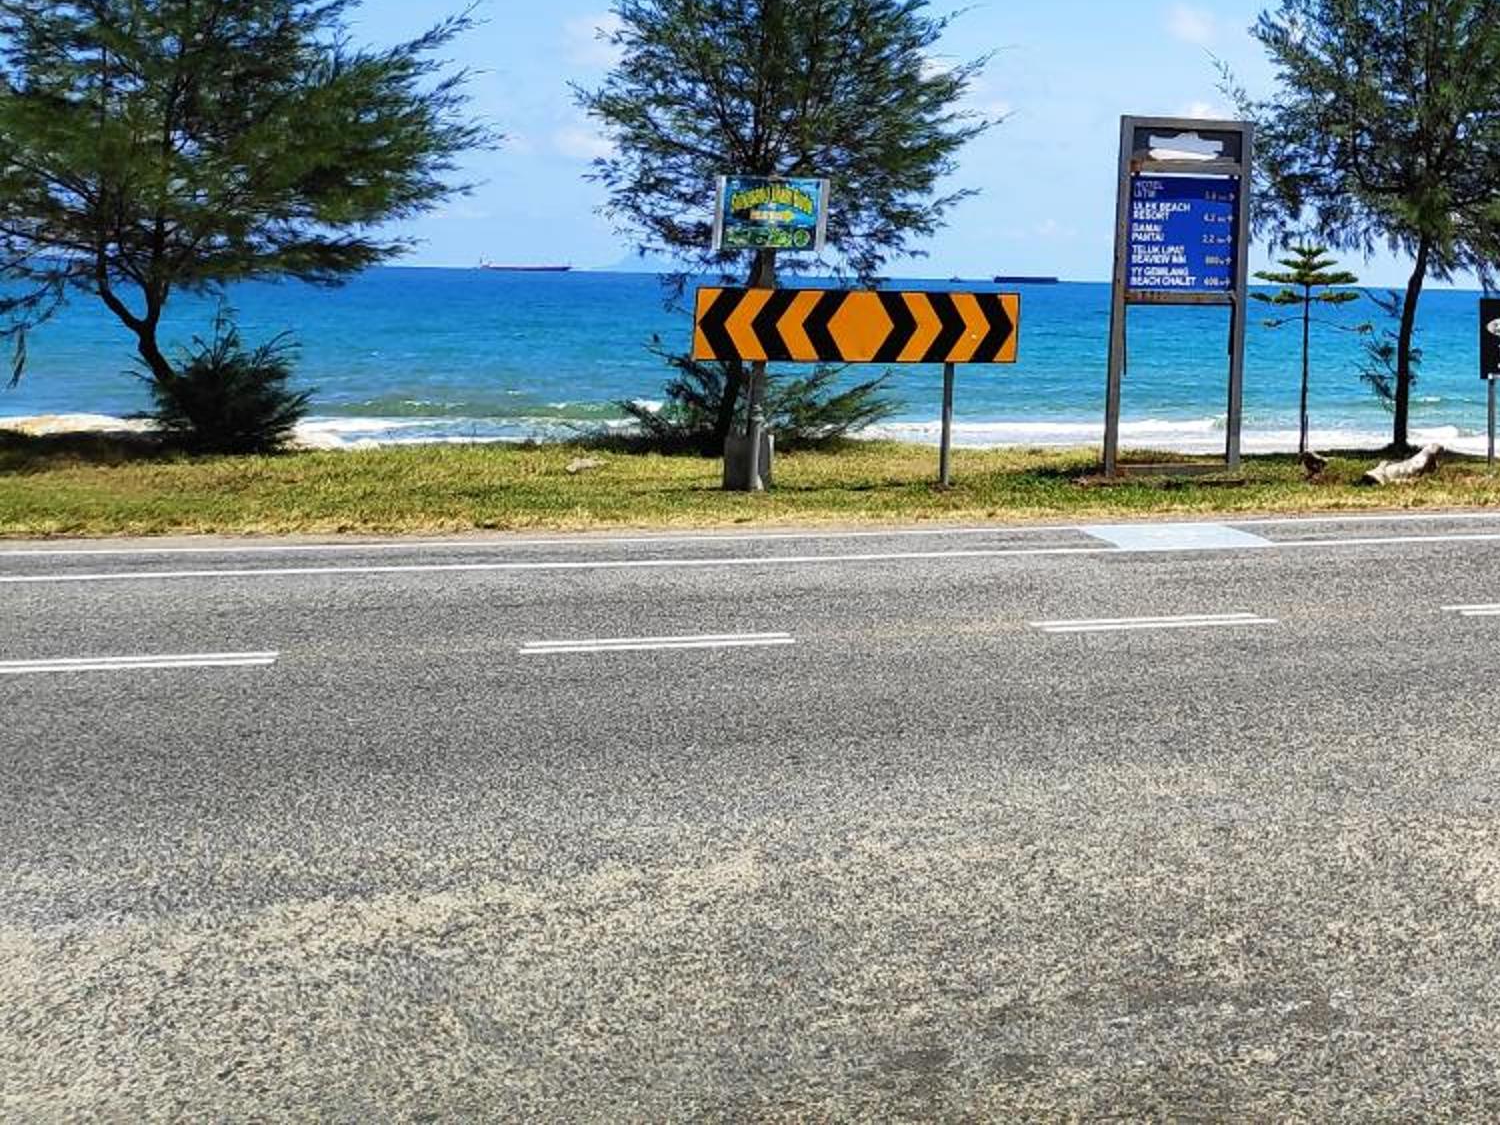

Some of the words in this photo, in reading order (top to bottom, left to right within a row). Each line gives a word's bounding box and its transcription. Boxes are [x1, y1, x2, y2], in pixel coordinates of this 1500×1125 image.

[1160, 202, 1191, 213] BEACH
[1133, 210, 1169, 221] RESORT
[1130, 276, 1161, 286] BEACH
[1162, 276, 1197, 287] CHALET
